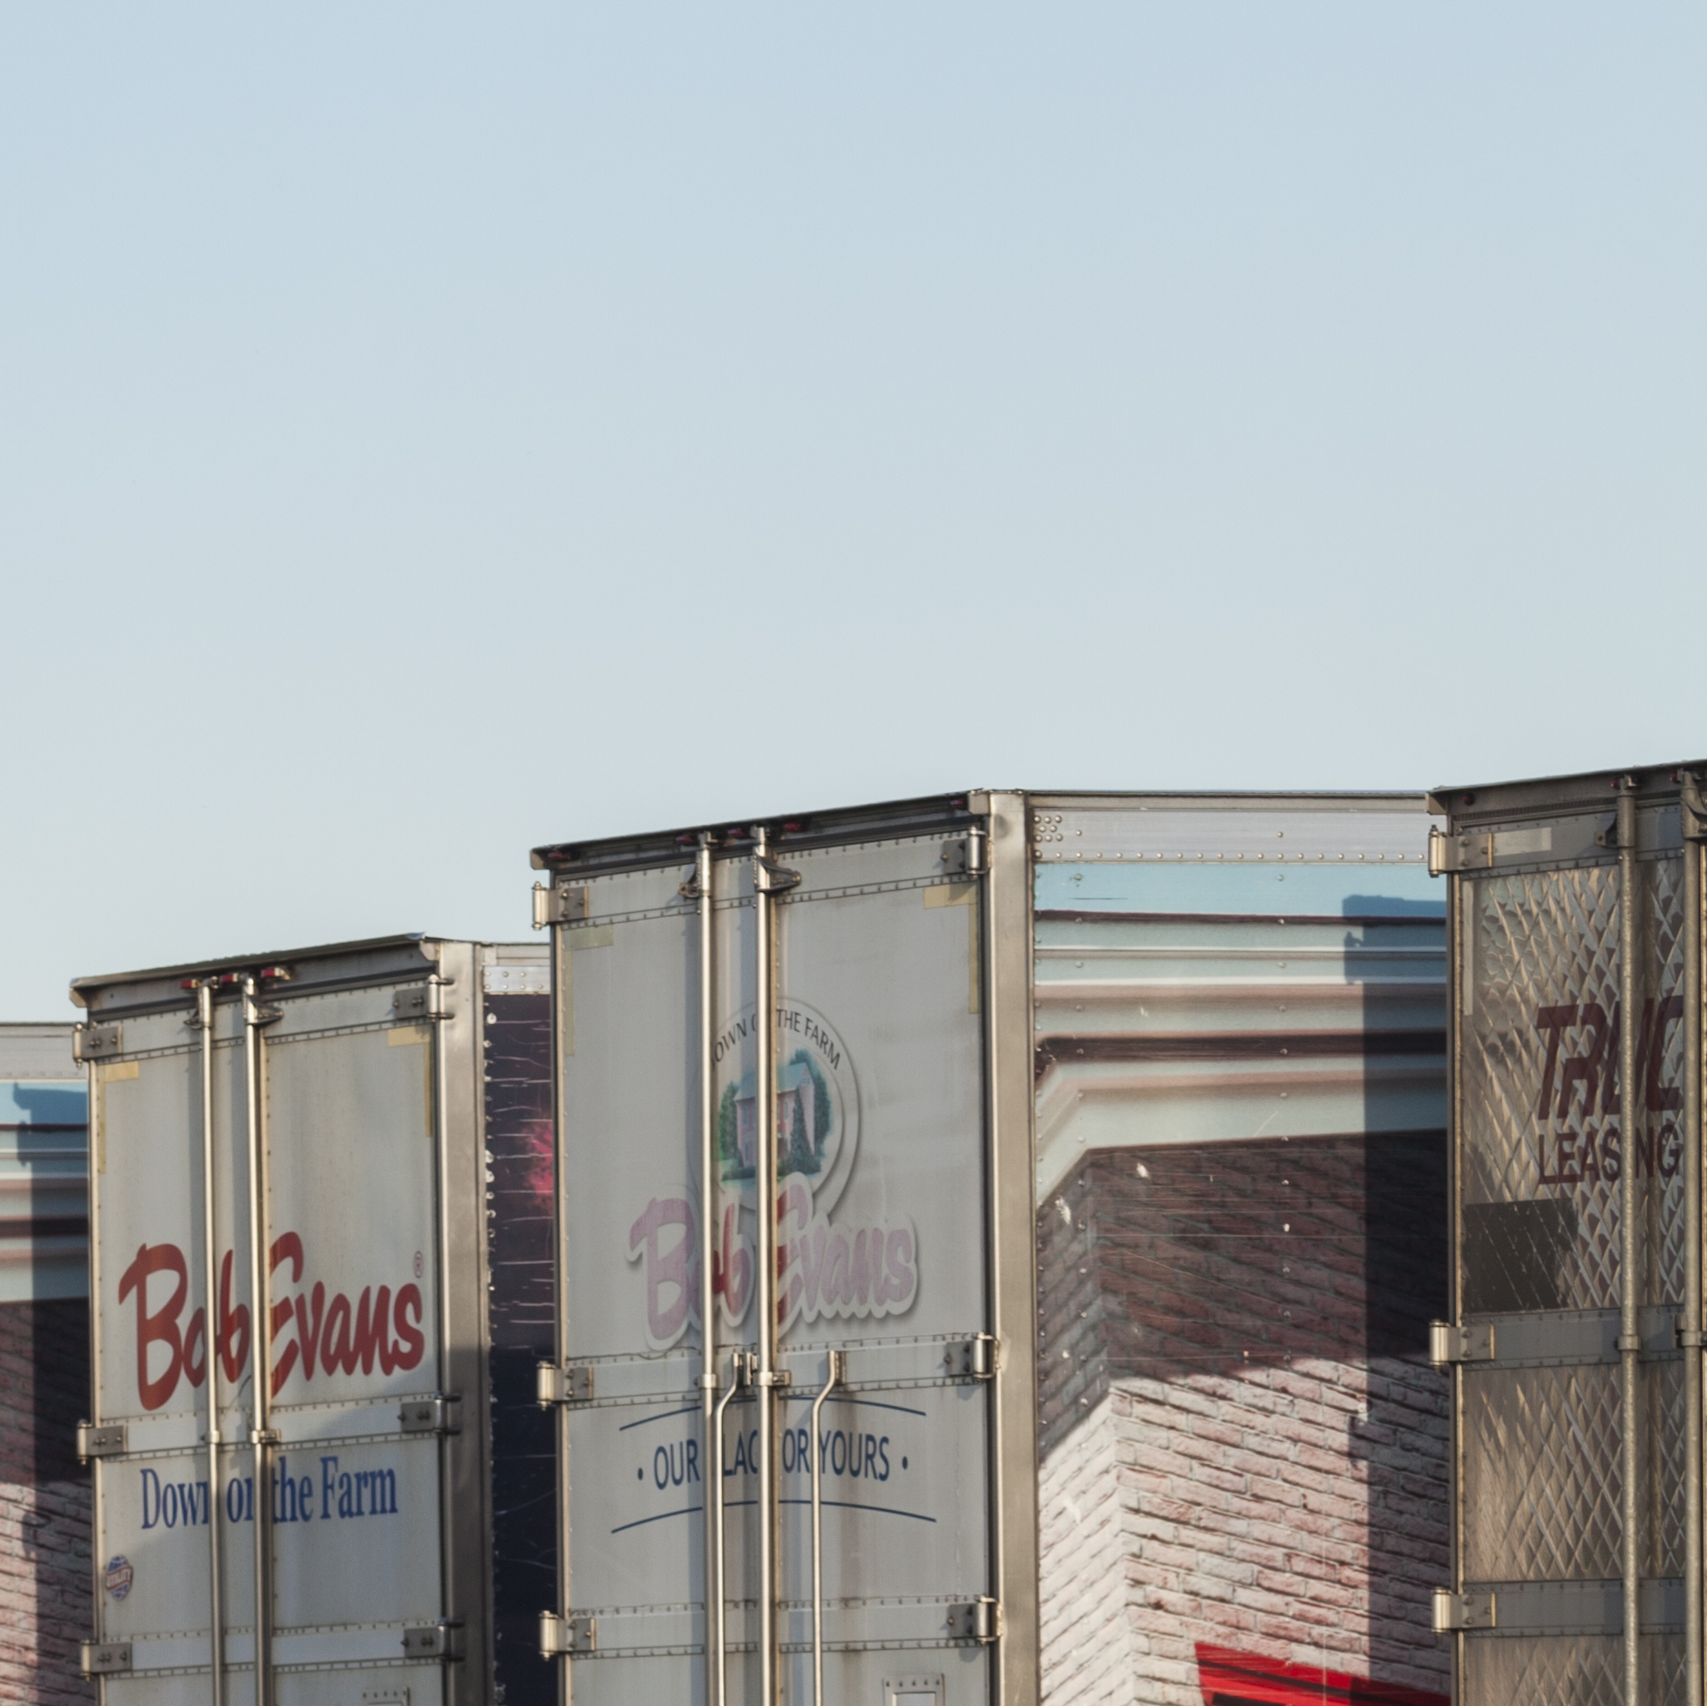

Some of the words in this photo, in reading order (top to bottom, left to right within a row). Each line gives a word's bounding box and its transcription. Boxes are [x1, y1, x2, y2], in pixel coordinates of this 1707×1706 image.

[776, 1008, 801, 1033] THE
[804, 1016, 840, 1070] FARM
[1538, 1124, 1680, 1184] LEASNG
[778, 1184, 915, 1326] Evans
[119, 1243, 250, 1411] Bob
[270, 1231, 425, 1399] Evans
[320, 1455, 398, 1519] Farm
[654, 1439, 700, 1490] OUR
[723, 1430, 758, 1477] LAC
[782, 1429, 809, 1473] OR
[819, 1430, 890, 1481] YOURS
